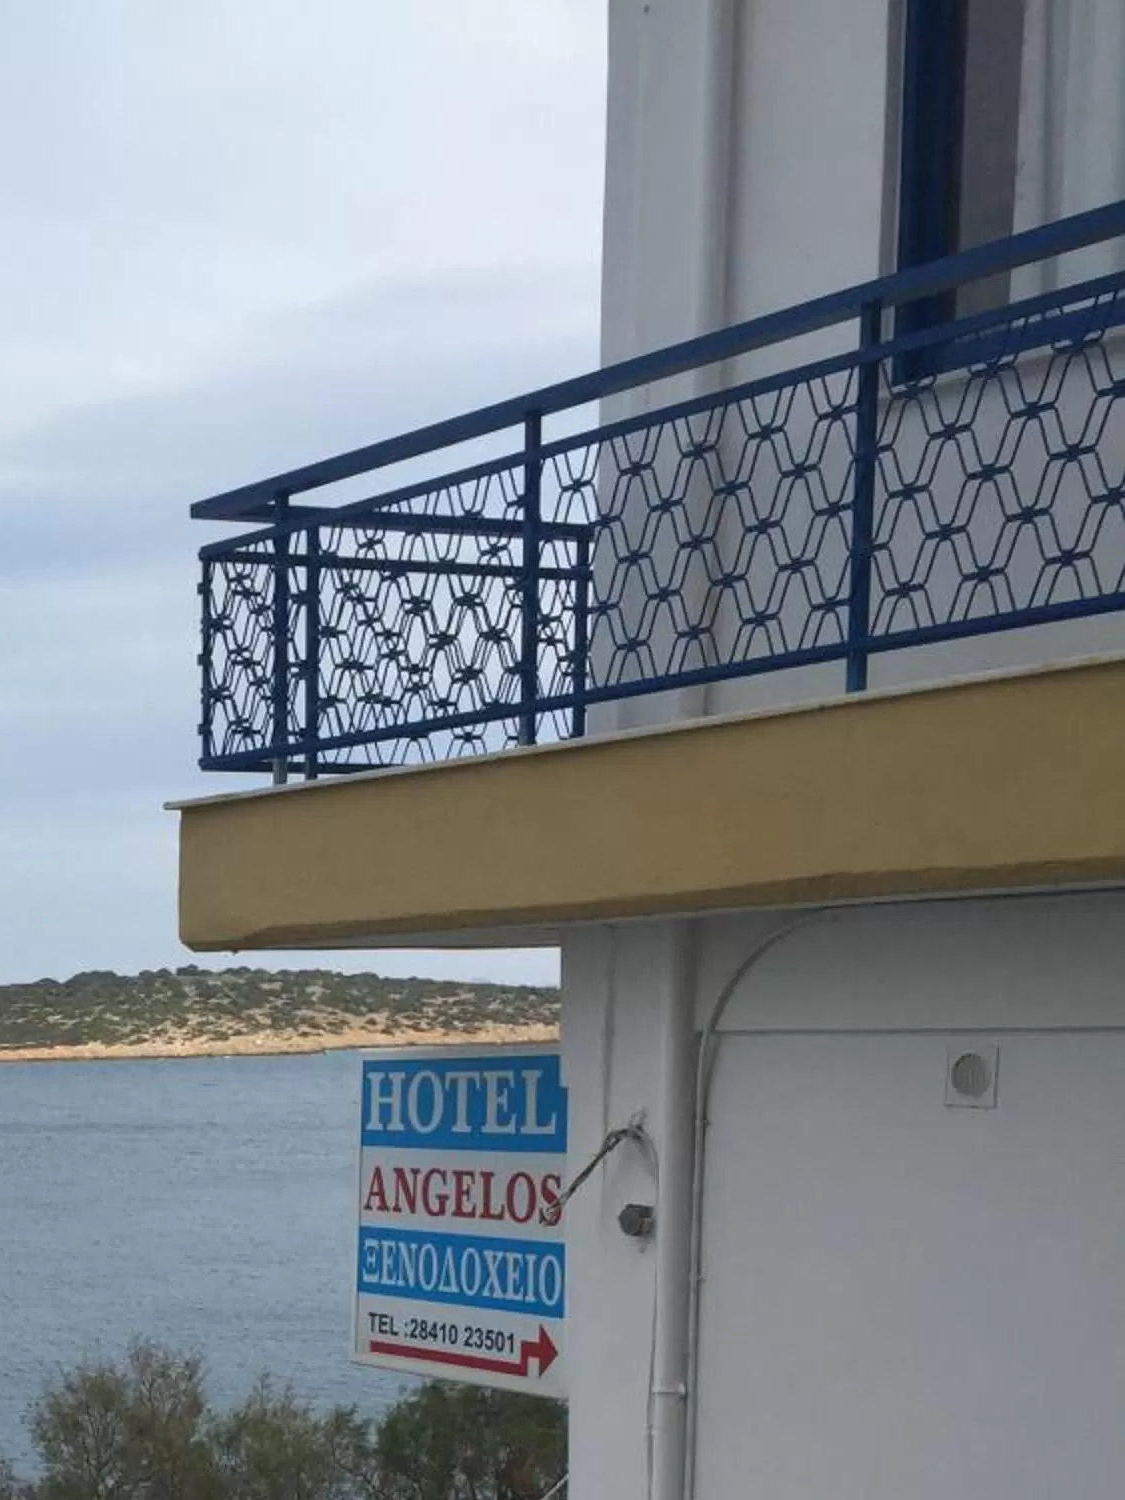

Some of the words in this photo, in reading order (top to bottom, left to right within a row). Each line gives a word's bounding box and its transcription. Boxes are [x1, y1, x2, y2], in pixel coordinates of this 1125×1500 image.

[365, 1069, 556, 1135] HOTEL
[364, 1166, 562, 1226] ANGELOS
[362, 1238, 562, 1306] ΞΕΝΟΔΟΧΕΙΟ
[463, 1326, 516, 1353] 23501
